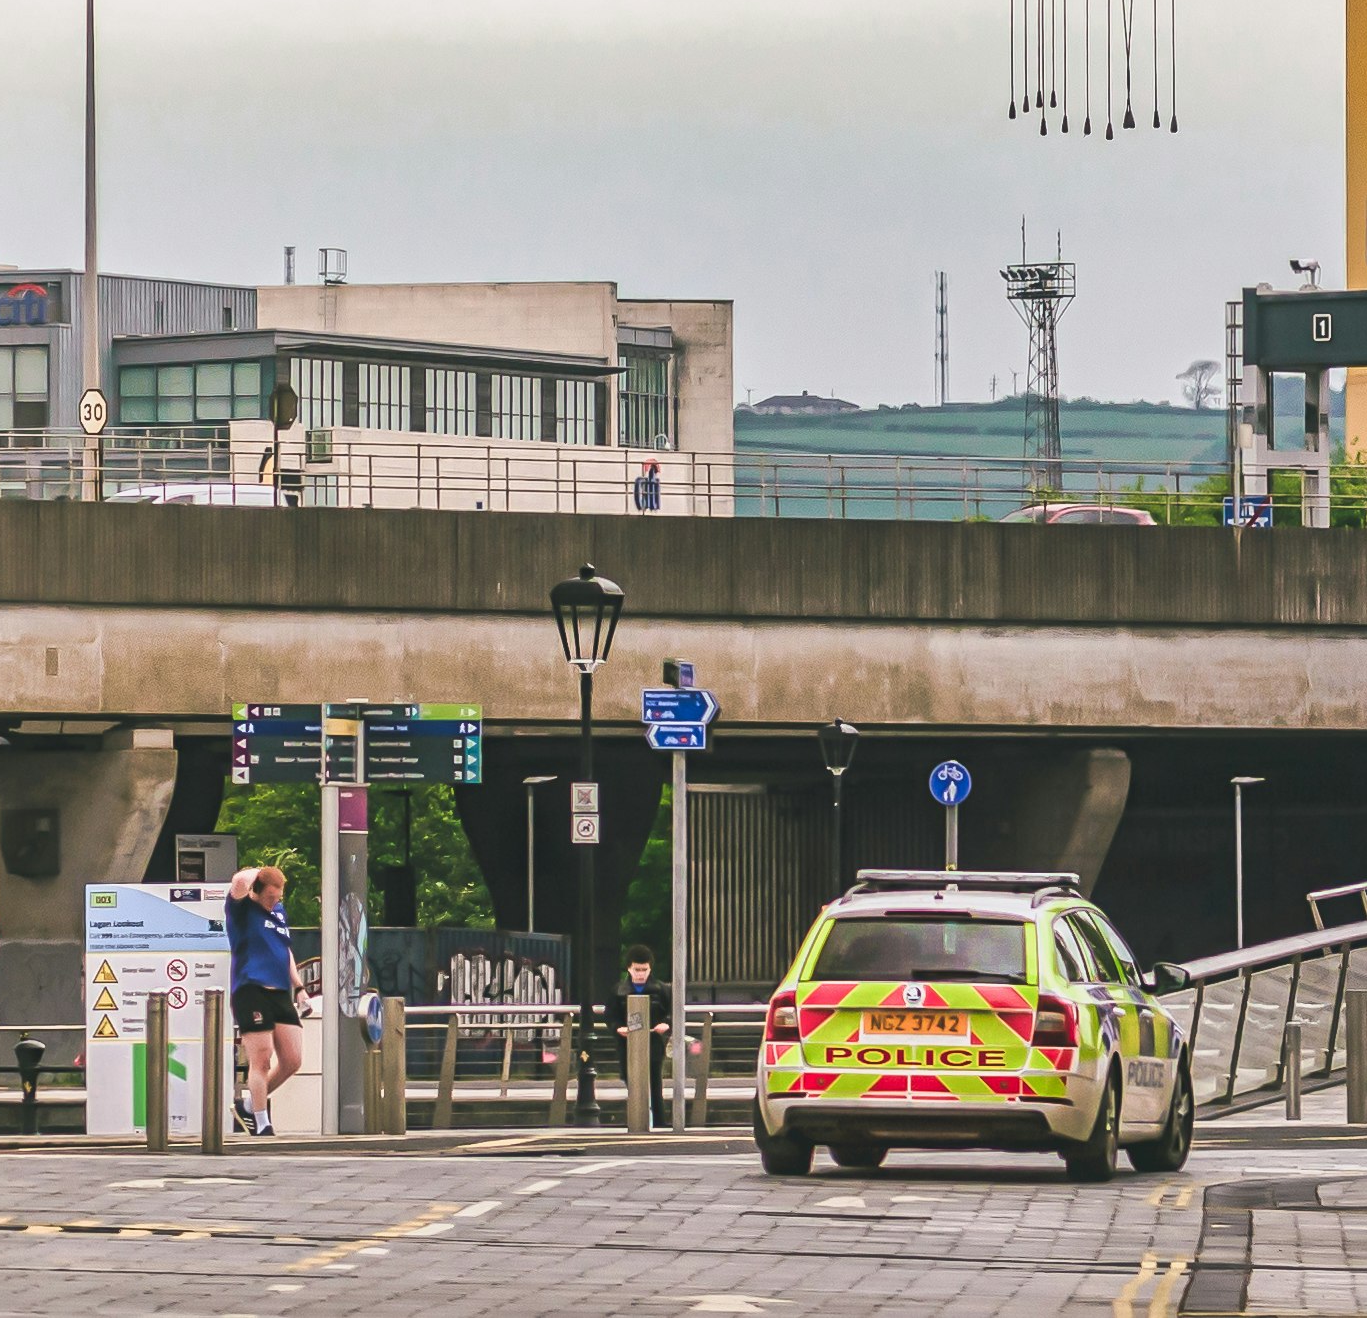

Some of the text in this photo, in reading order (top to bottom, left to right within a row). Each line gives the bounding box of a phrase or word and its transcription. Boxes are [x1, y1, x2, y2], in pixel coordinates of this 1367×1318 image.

[1319, 319, 1326, 336] 1
[83, 403, 103, 421] 30
[870, 1014, 960, 1032] NGZ 3742
[825, 1046, 1006, 1068] POLICE
